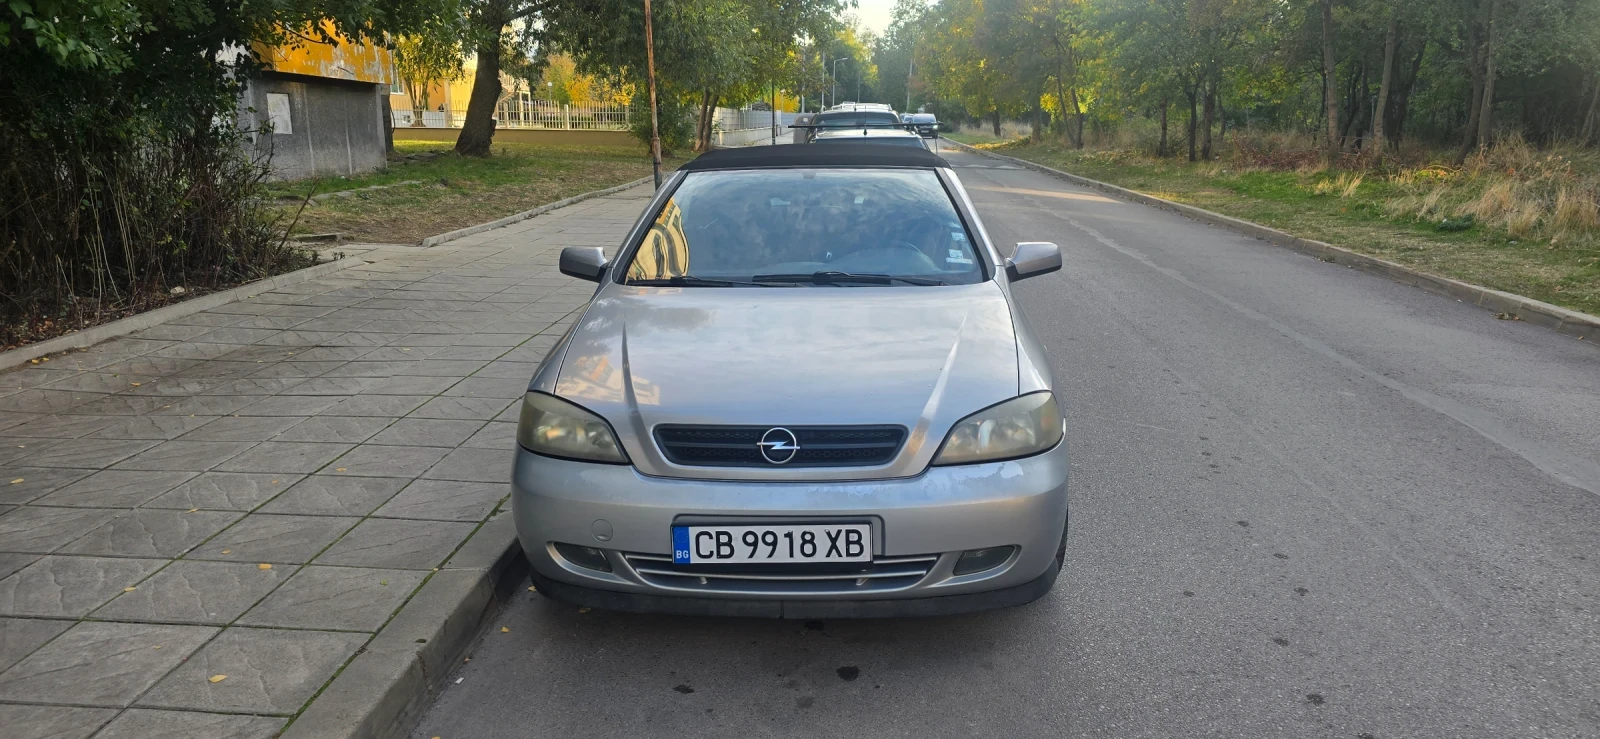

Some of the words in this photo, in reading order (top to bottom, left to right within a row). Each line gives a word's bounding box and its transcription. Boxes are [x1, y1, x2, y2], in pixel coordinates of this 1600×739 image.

[695, 531, 735, 559] CB
[742, 530, 817, 559] 9918
[825, 529, 864, 558] XB
[676, 550, 689, 559] BG
